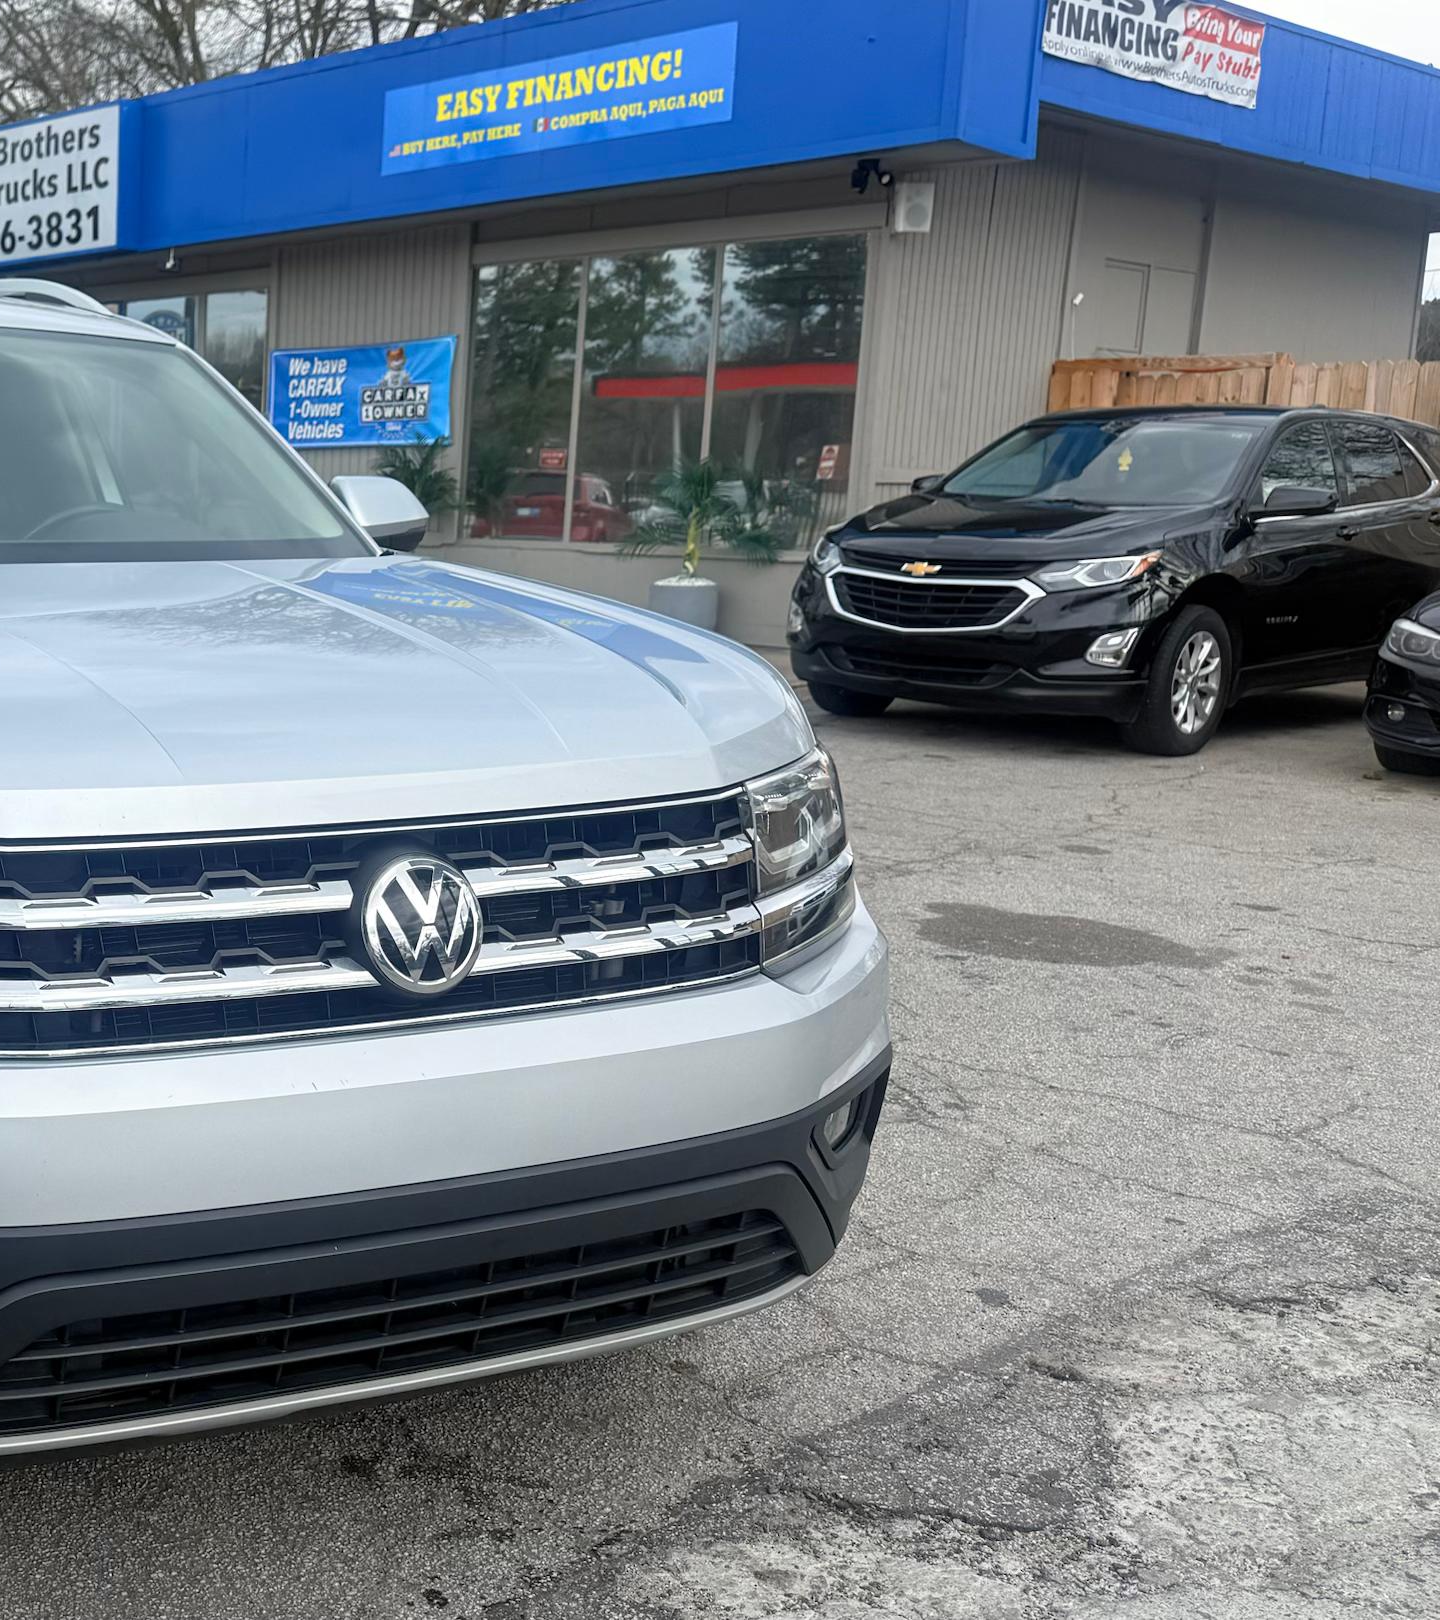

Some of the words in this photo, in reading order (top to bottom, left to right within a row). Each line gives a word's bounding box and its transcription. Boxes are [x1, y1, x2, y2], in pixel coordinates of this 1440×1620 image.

[1046, 0, 1179, 62] FINANCING
[1187, 7, 1225, 43] Bring
[1227, 19, 1260, 48] Your
[1043, 36, 1069, 56] Apply
[1182, 41, 1213, 73] Pay
[1217, 51, 1261, 80] Stub!
[436, 85, 502, 121] EASY
[506, 48, 683, 110] FINANCING!
[551, 109, 608, 130] COMPRA
[609, 102, 647, 122] AQUI,
[648, 95, 686, 114] PAGA
[688, 87, 724, 109] AQUI
[401, 139, 424, 156] BUY
[426, 132, 461, 151] HERE,
[463, 128, 485, 145] PAY
[487, 123, 522, 142] HERE
[67, 156, 109, 195] LLC
[288, 356, 310, 376] We
[312, 356, 347, 376] have
[288, 376, 346, 398] CARFAX
[362, 387, 428, 403] CARFAX
[289, 400, 344, 418] 1-Owner
[288, 421, 344, 440] Vehicles
